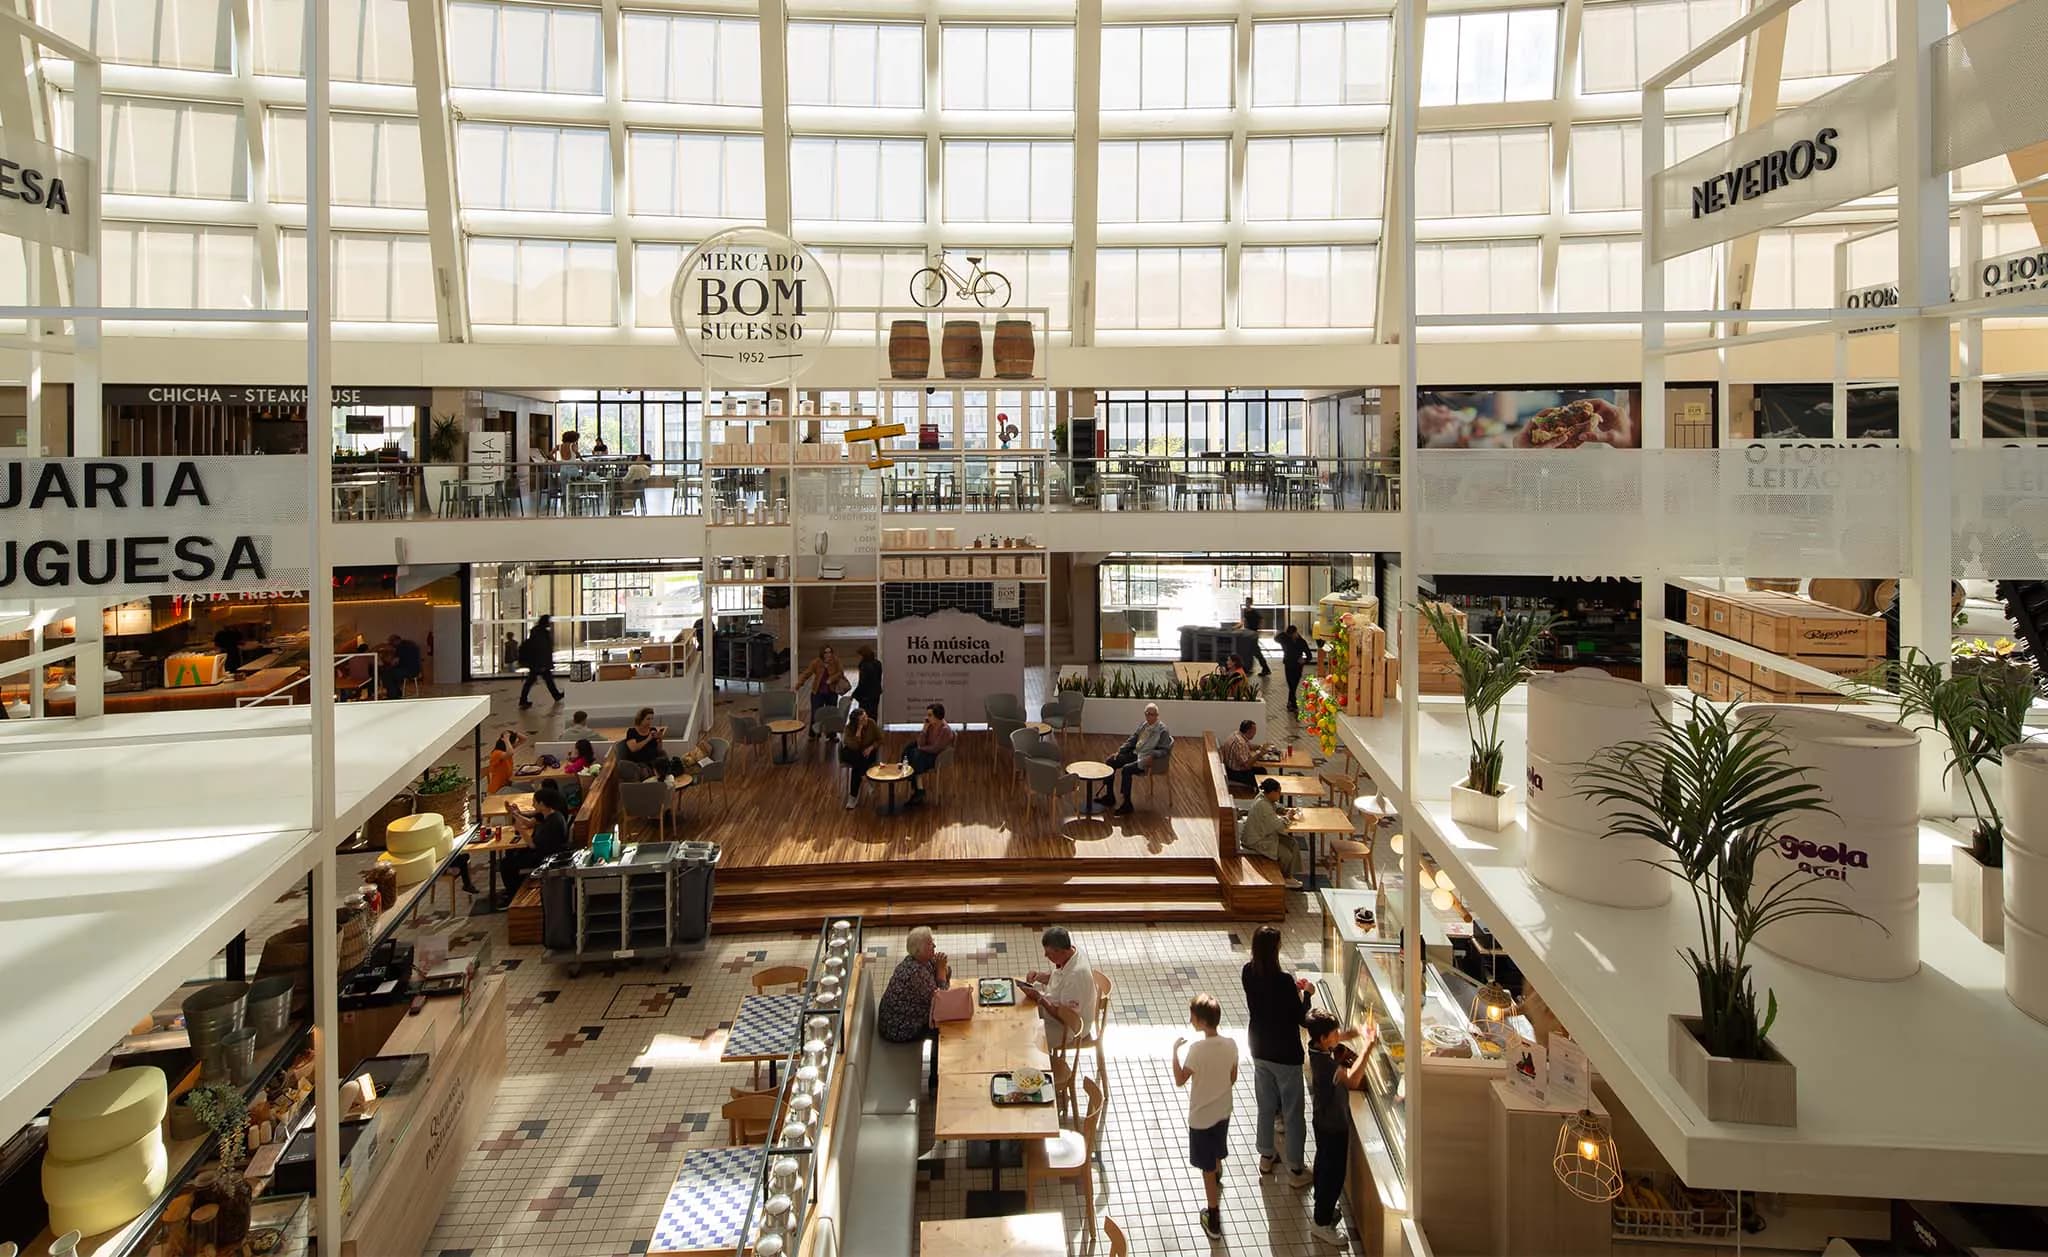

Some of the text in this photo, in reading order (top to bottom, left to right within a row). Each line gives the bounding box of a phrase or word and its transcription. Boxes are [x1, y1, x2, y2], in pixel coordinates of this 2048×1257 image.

[1692, 128, 1838, 219] NEVEIROS
[700, 253, 803, 272] MERCADO
[1983, 264, 2000, 287] O
[697, 278, 806, 316] BOM
[701, 322, 802, 340] SUCESSO
[739, 352, 764, 363] 1952
[149, 388, 222, 402] CHICHA
[907, 635, 990, 649] Há música
[907, 650, 1004, 664] no Mercado!
[1780, 835, 1868, 868] goola
